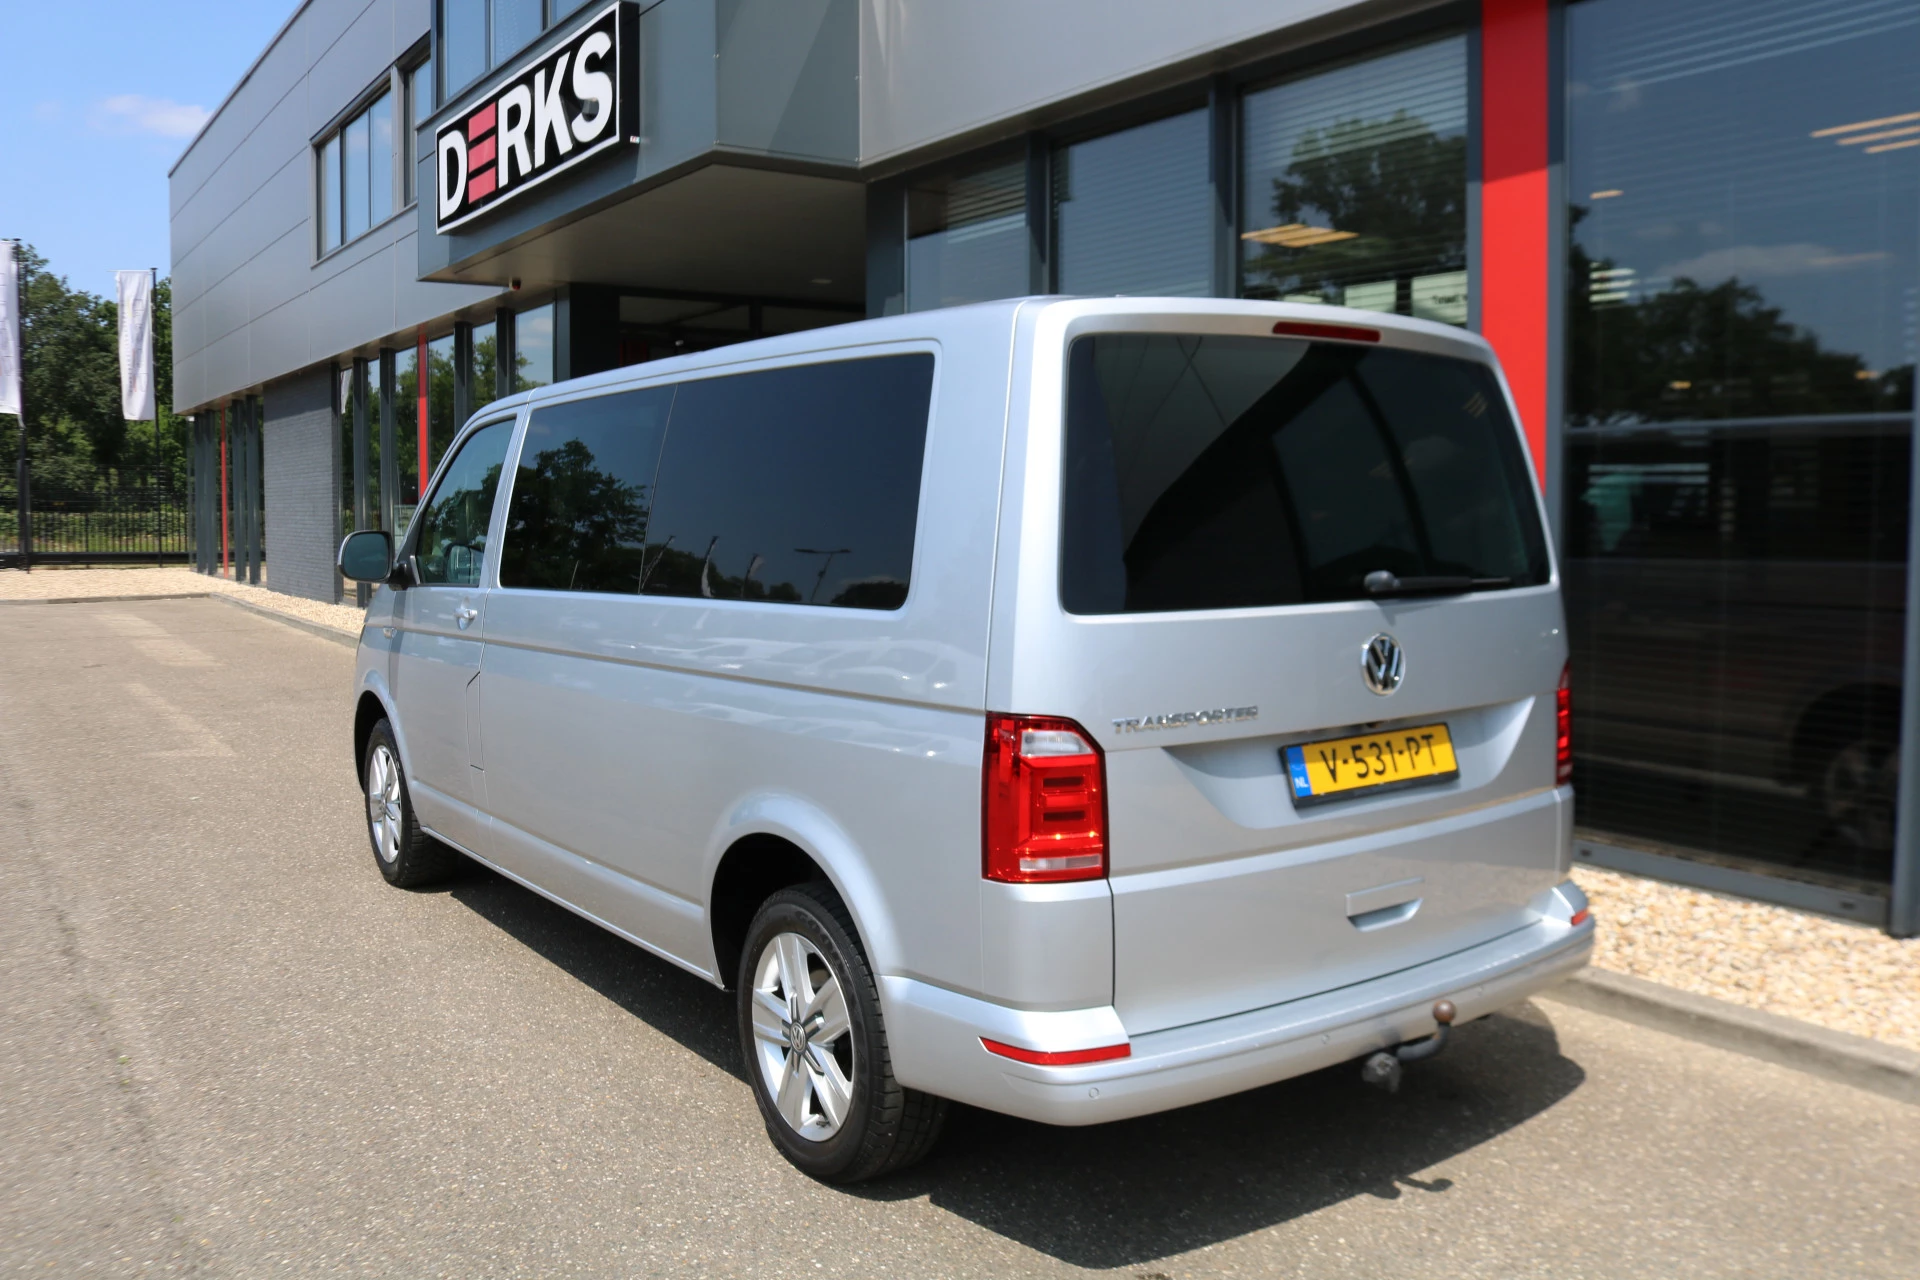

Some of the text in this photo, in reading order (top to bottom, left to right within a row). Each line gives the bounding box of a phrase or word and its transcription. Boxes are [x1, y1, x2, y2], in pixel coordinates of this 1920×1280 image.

[439, 31, 613, 221] DERKS
[1112, 705, 1259, 734] TRANSPORTER
[1320, 733, 1435, 783] V-531-PT
[1294, 776, 1309, 788] NL
